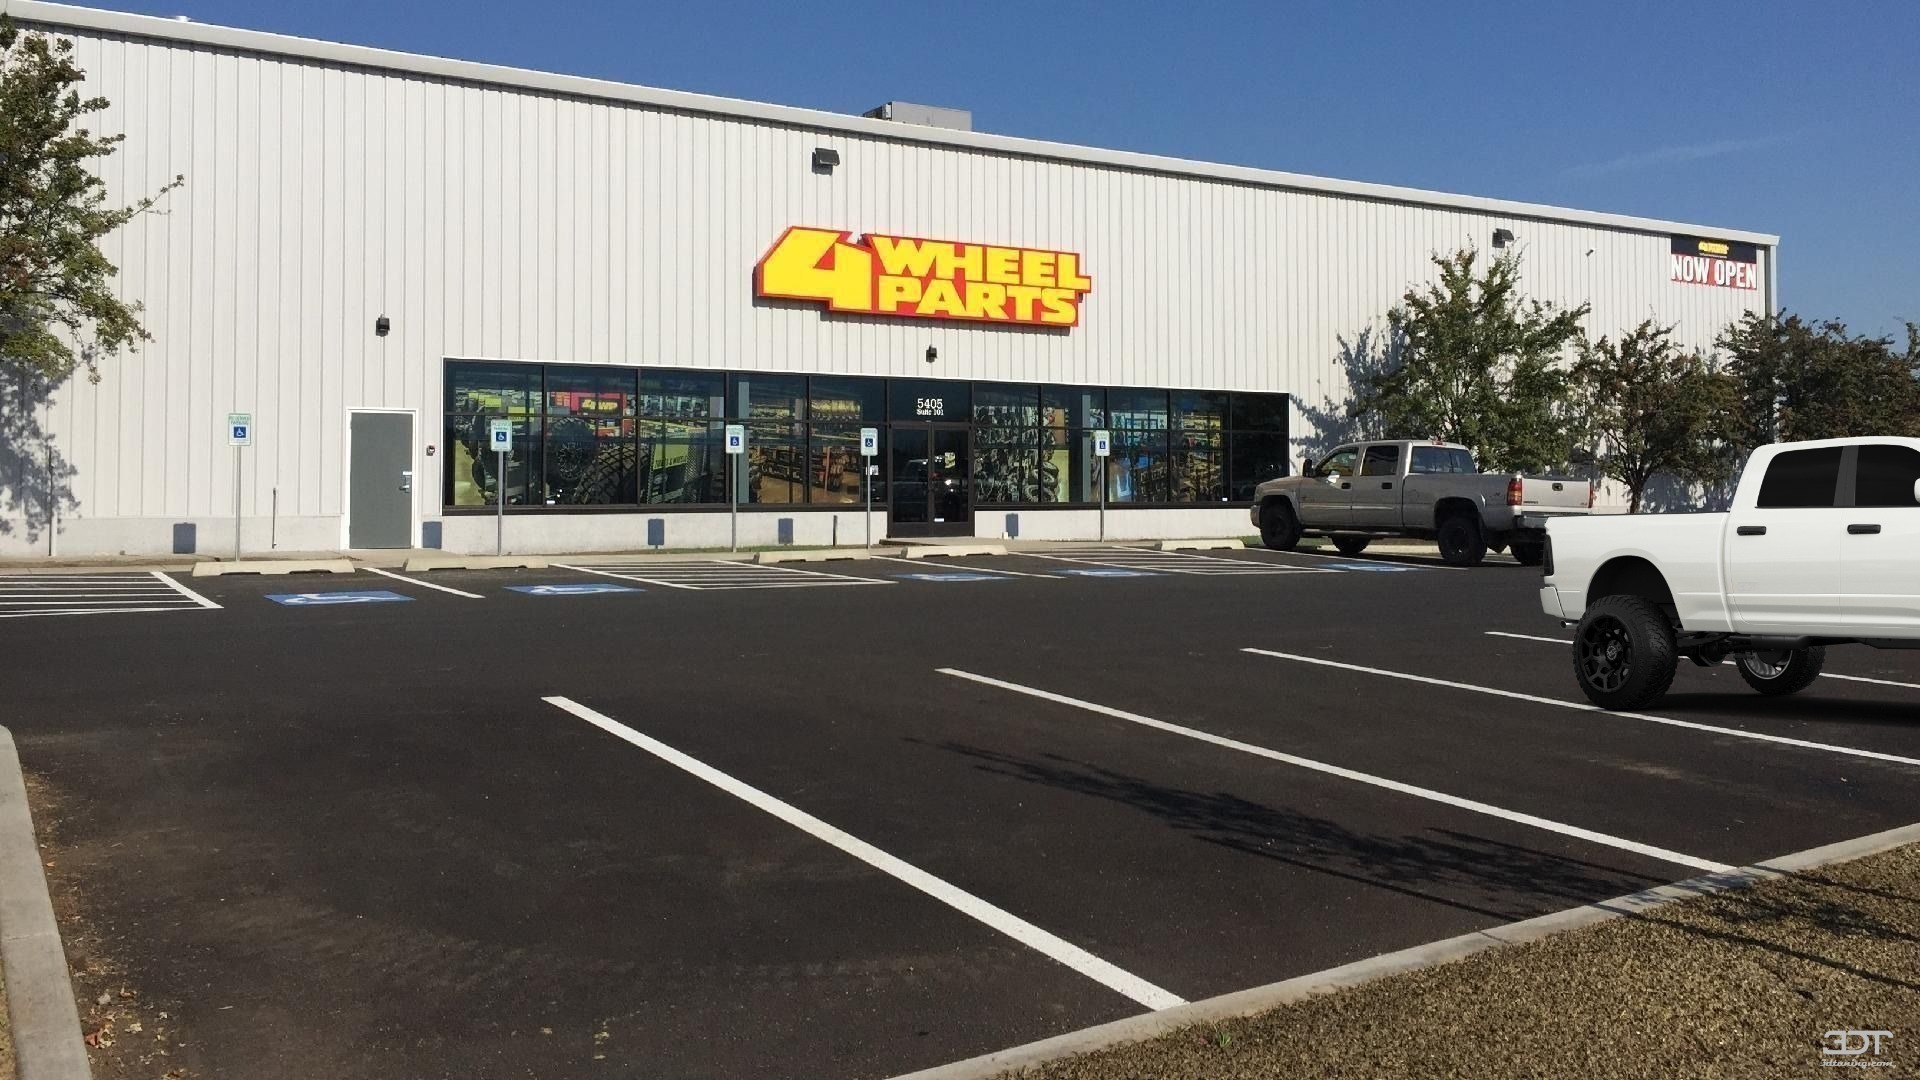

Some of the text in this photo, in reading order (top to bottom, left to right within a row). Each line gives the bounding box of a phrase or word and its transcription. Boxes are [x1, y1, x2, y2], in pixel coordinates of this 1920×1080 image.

[763, 229, 1092, 311] 4 WHEEL
[1671, 254, 1757, 289] NOW OPEN
[878, 275, 1078, 325] PARTS
[917, 398, 943, 409] 5405
